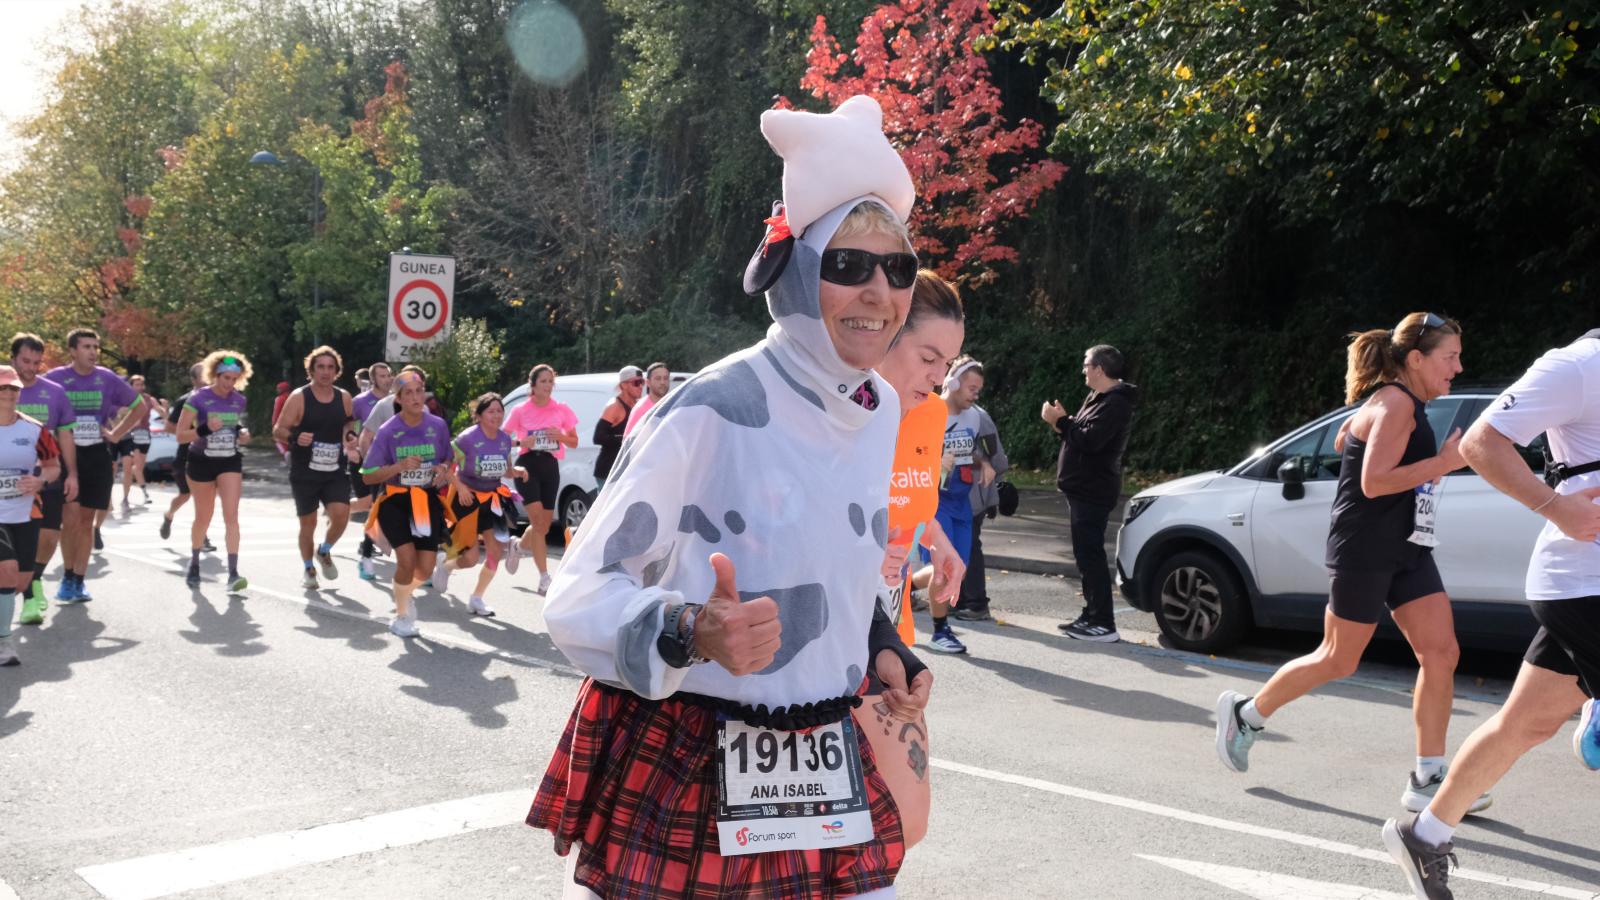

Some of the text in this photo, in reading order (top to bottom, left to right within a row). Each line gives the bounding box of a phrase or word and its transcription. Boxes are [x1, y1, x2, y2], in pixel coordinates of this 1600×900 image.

[400, 261, 446, 275] GUNEA
[406, 300, 437, 320] 30
[945, 438, 973, 449] 21530
[482, 462, 507, 472] 22981
[730, 731, 843, 773] 19136
[751, 783, 827, 799] ANA ISABEL
